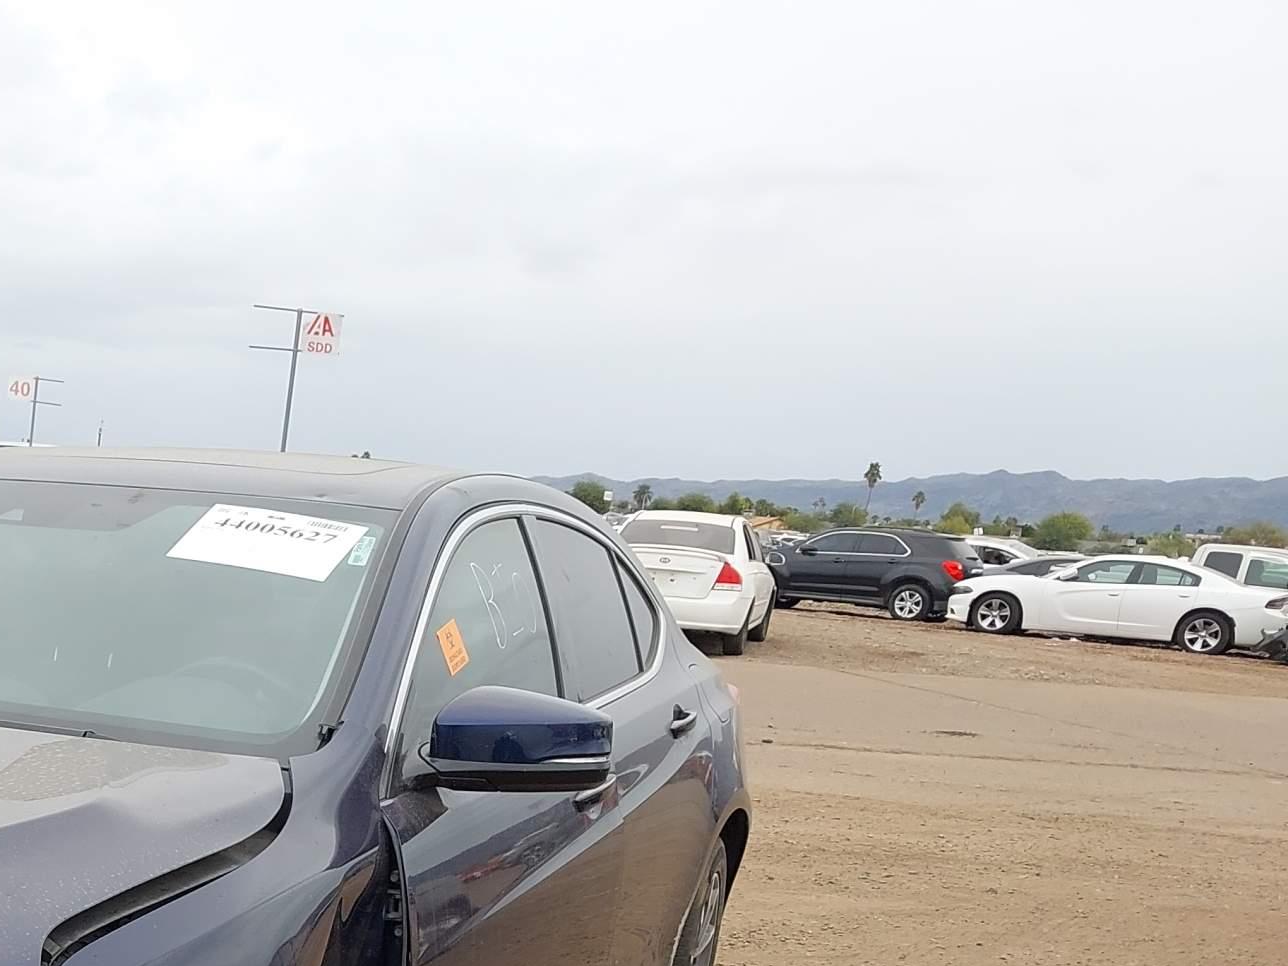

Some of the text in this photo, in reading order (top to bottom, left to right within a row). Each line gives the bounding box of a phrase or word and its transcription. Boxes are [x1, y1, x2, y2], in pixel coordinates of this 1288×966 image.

[307, 341, 332, 353] SDD
[9, 380, 31, 397] 40
[215, 518, 338, 543] 44005627
